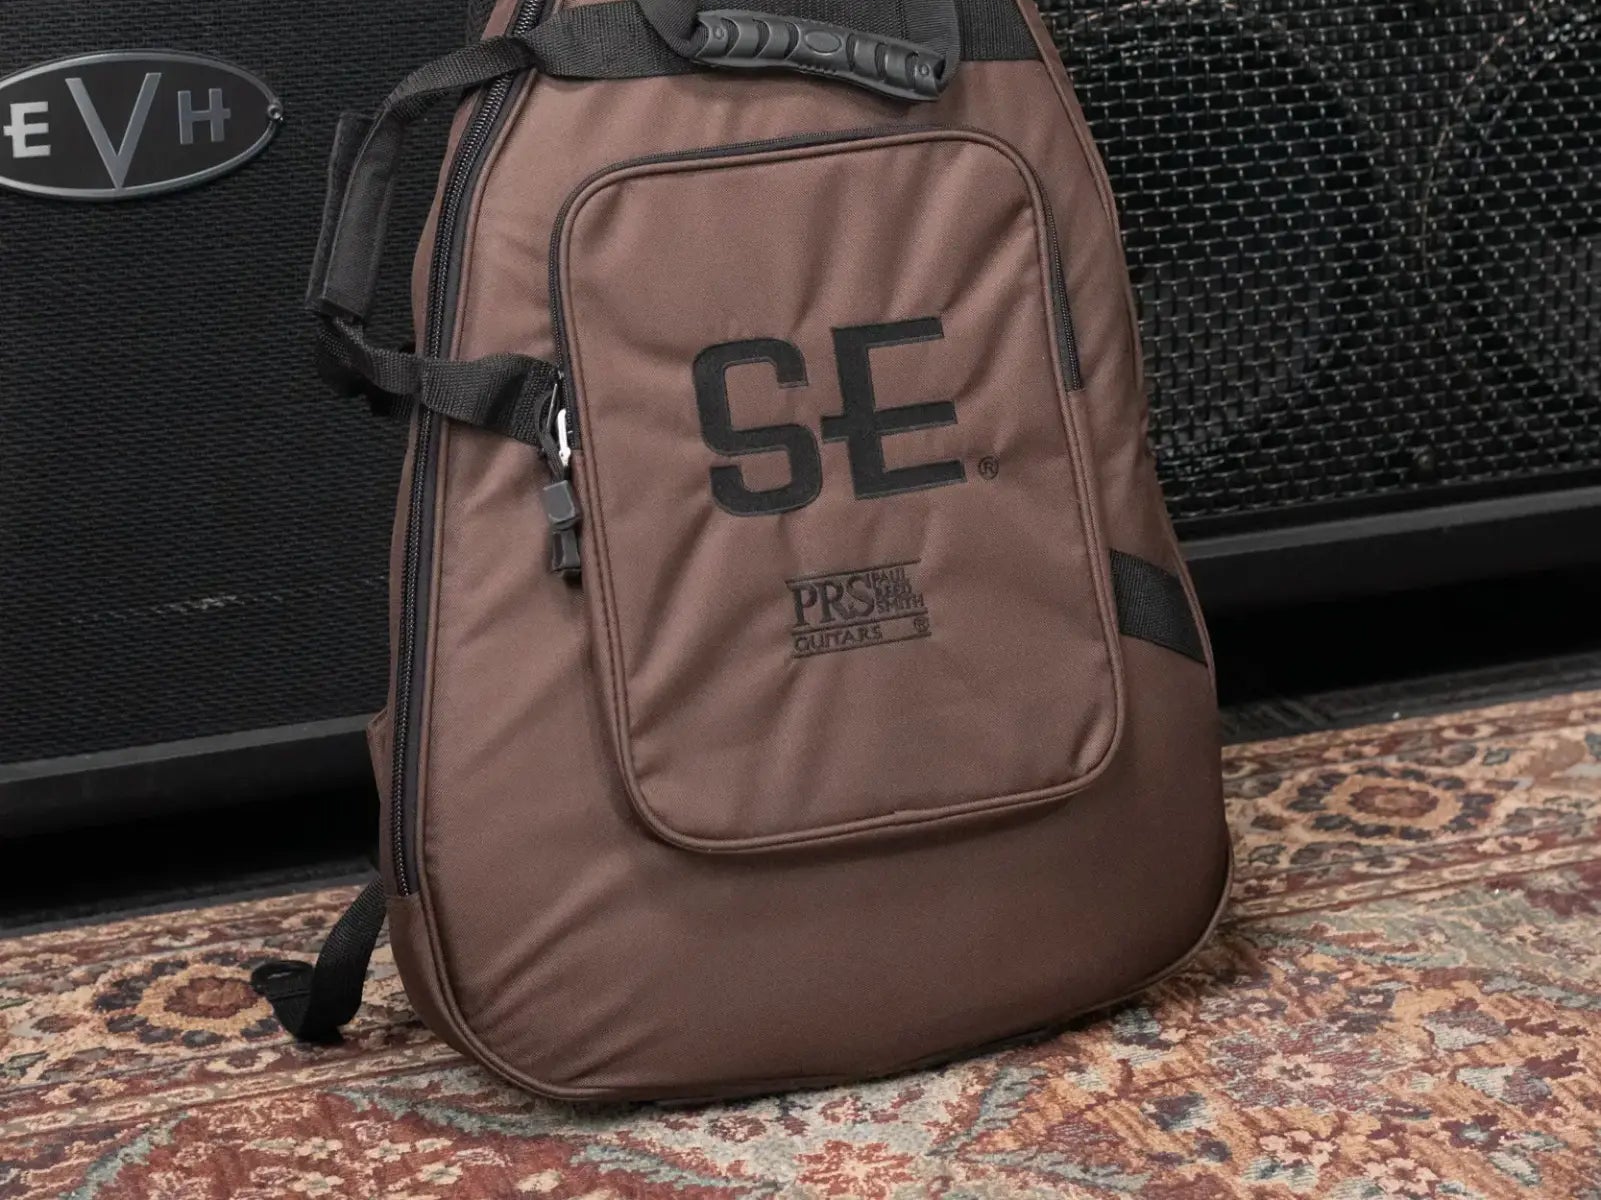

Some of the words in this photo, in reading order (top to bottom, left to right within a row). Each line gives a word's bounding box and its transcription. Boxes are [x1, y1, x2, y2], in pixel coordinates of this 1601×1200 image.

[3, 71, 232, 190] EVH
[691, 316, 968, 517] SE
[785, 573, 875, 628] PRS
[794, 624, 884, 652] GUITARS
